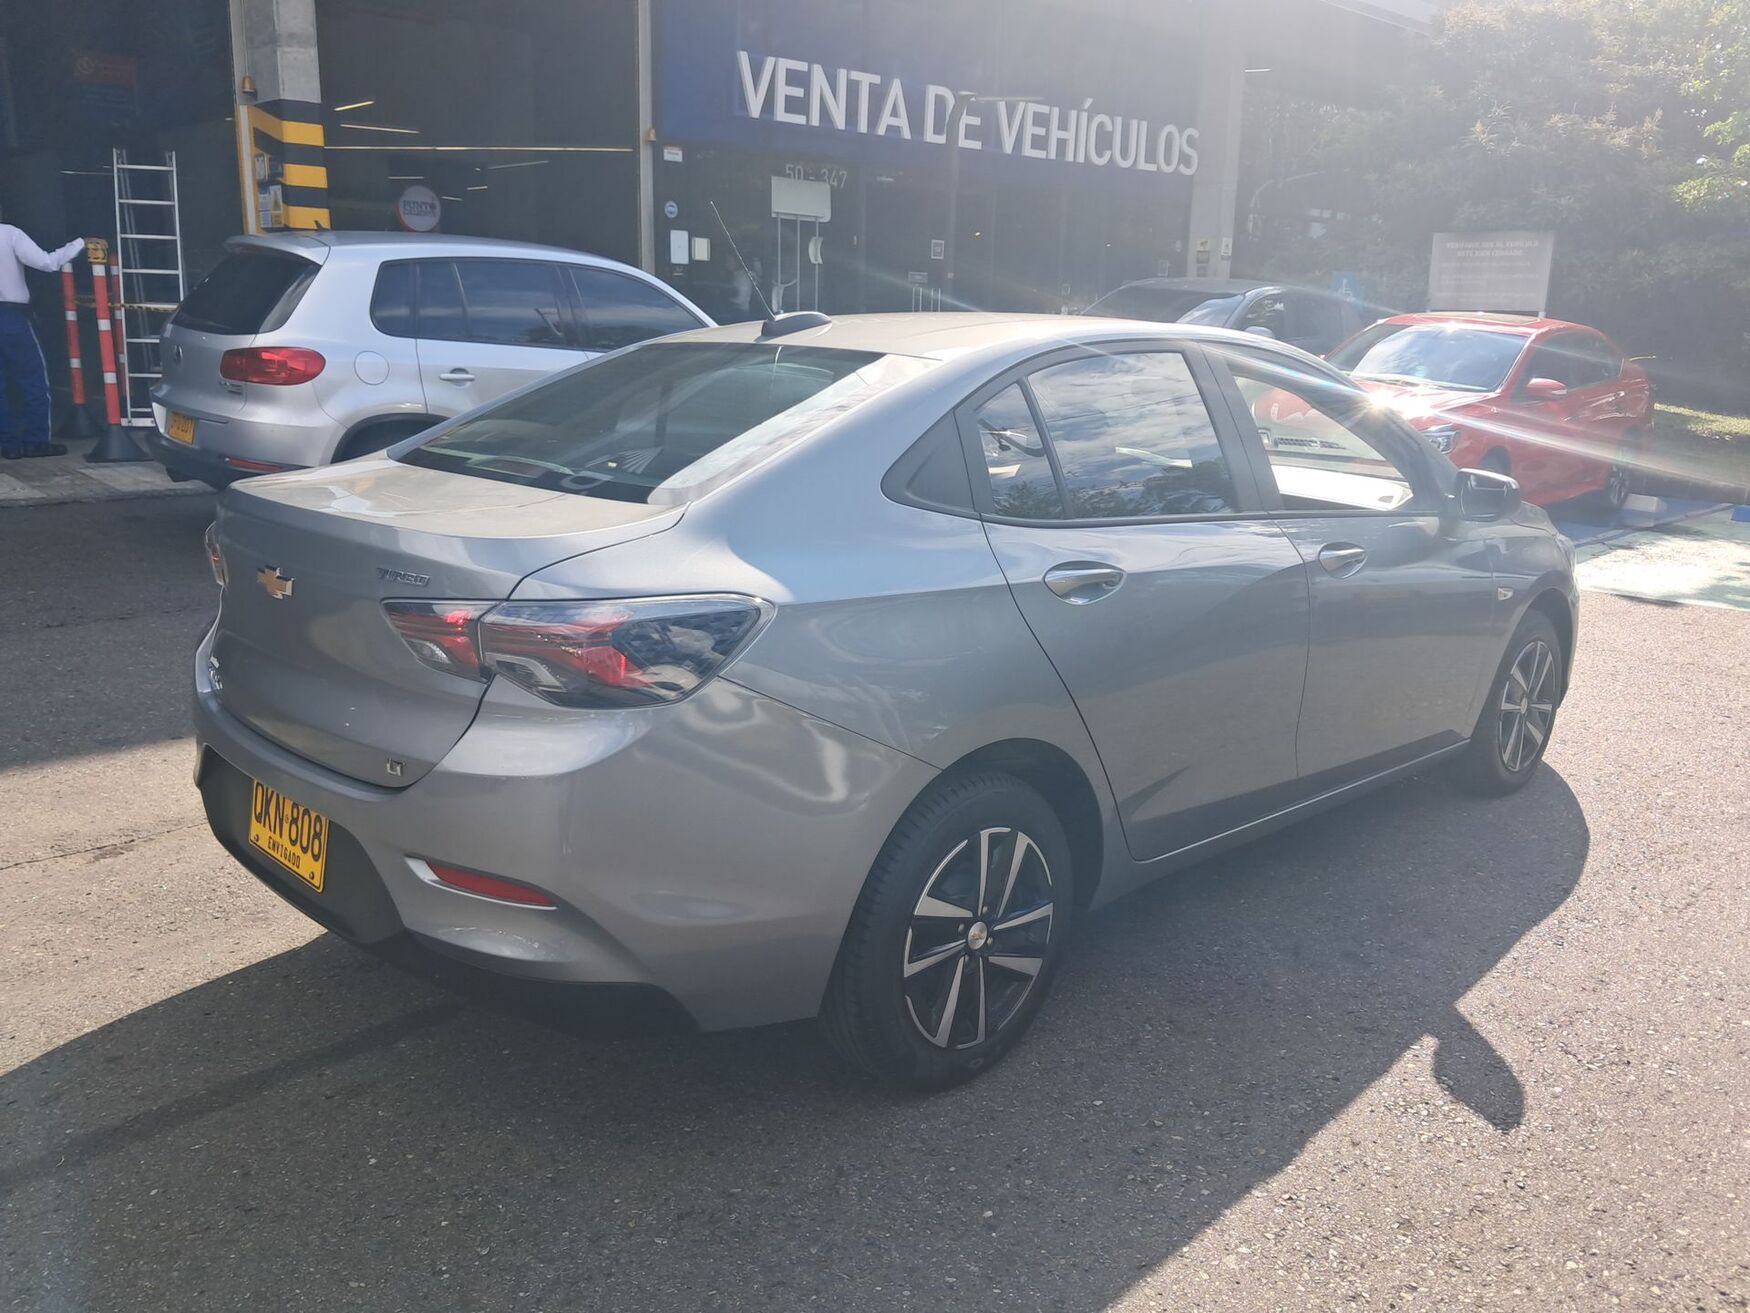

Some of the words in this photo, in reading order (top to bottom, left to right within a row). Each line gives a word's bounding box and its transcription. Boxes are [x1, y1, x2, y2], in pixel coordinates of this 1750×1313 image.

[736, 50, 912, 140] VENTA
[924, 84, 983, 150] DE
[998, 98, 1200, 176] VEHÍCULOS
[785, 163, 804, 181] 50
[820, 168, 848, 189] 347
[267, 836, 301, 870] ENVIGADO
